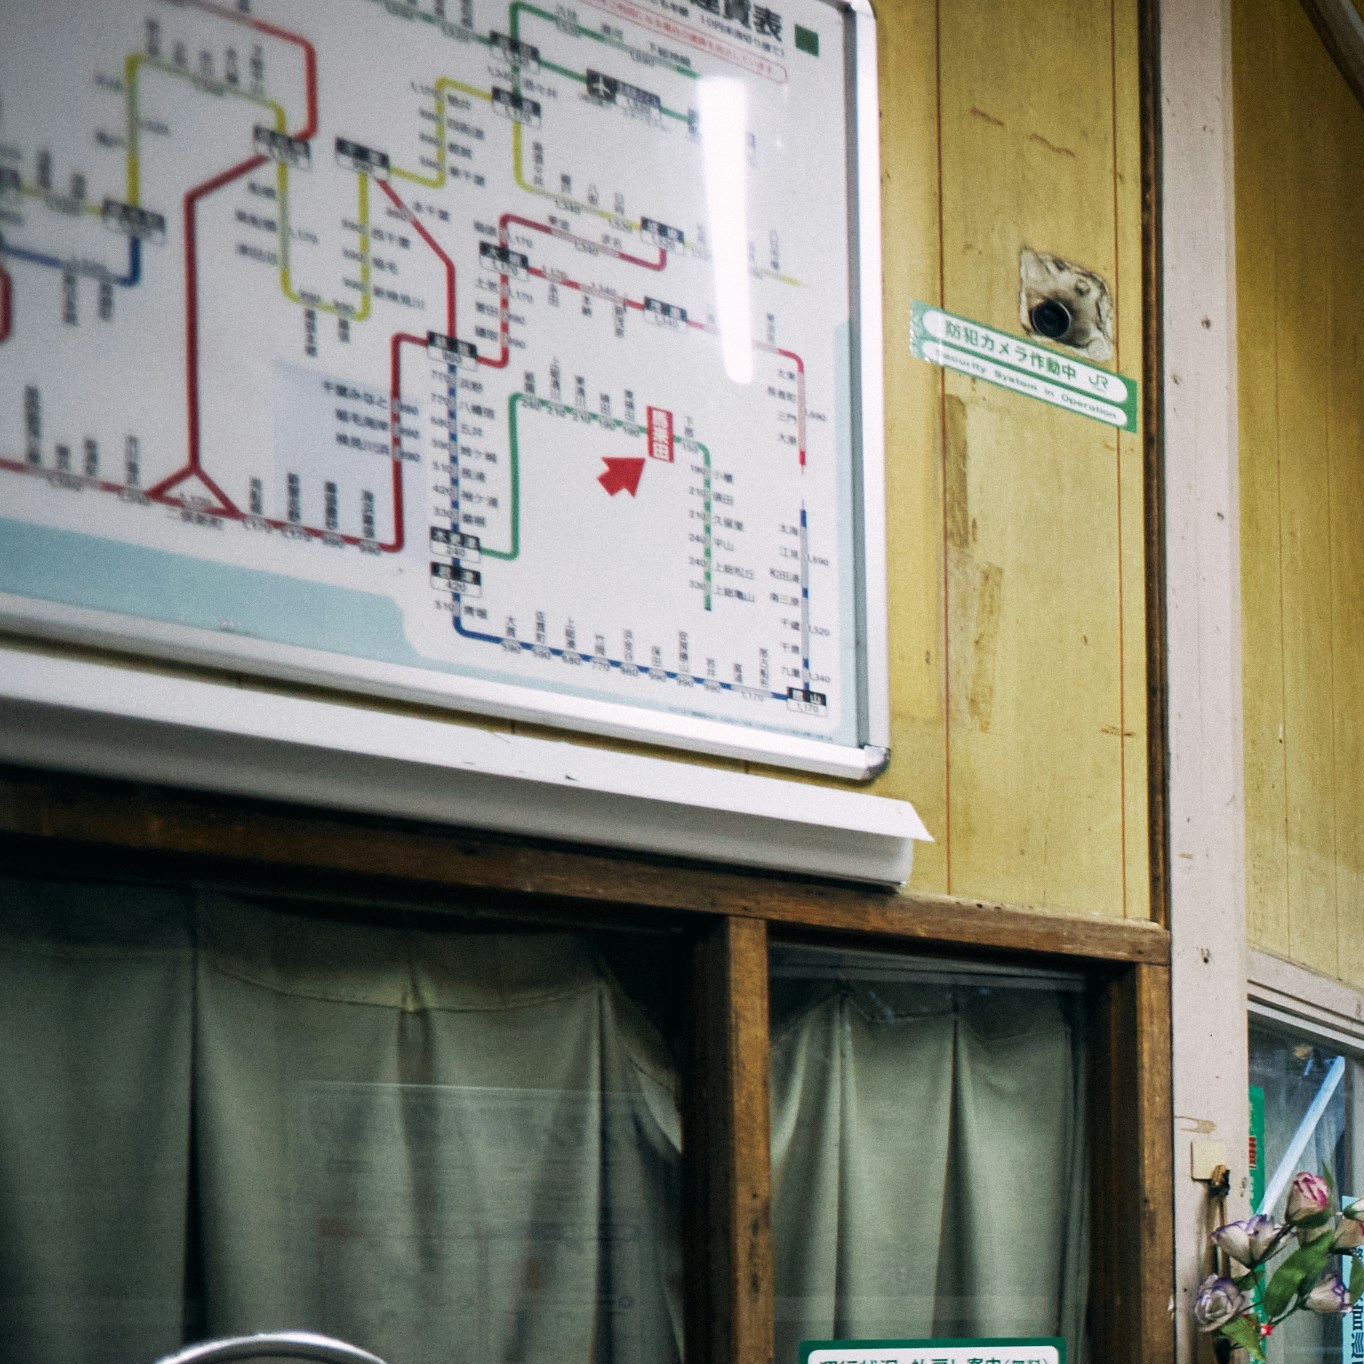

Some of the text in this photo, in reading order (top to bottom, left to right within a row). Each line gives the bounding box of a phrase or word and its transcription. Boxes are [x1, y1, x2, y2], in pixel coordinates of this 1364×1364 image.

[945, 320, 1108, 389] 防犯カメラ作動中 JR
[994, 370, 1038, 391] System
[1045, 386, 1055, 396] in
[1061, 394, 1117, 418] Operation
